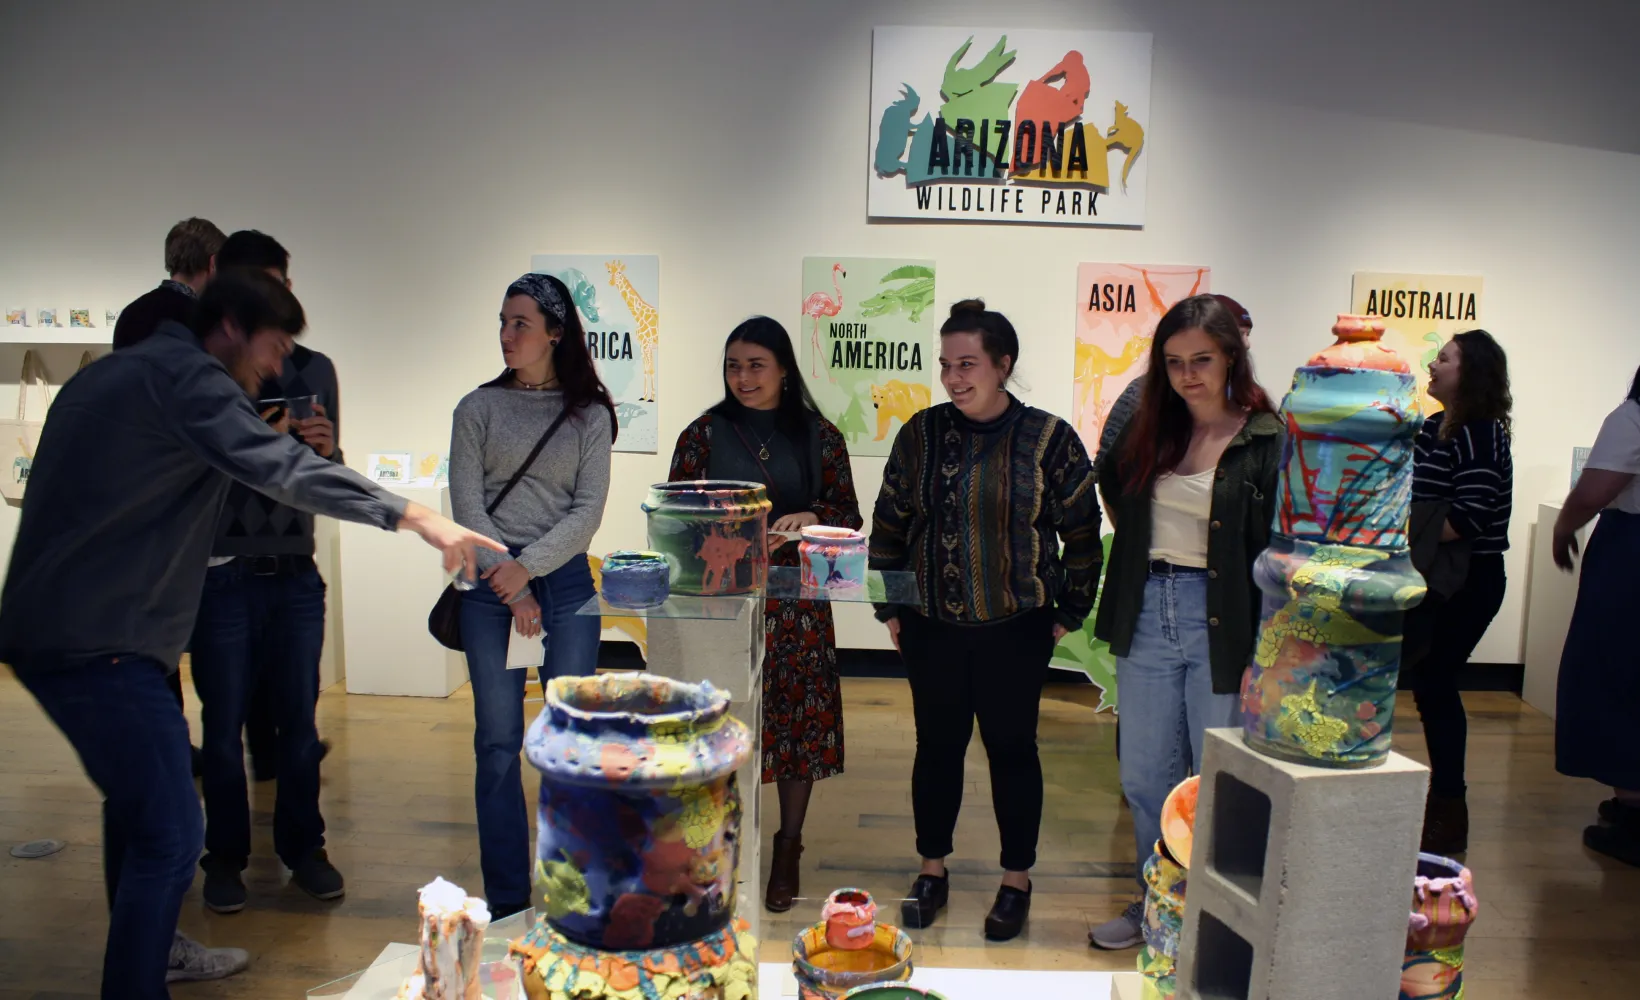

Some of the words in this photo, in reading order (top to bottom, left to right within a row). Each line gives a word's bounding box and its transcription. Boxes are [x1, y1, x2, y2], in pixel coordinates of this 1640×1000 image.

[928, 117, 1089, 173] ARIZONA
[916, 185, 1024, 214] WILDLIFE
[1041, 189, 1099, 217] PARK
[1088, 283, 1136, 313] ASIA
[1366, 289, 1477, 321] AUSTRALIA
[583, 331, 633, 360] RICA
[829, 322, 867, 339] NORTH
[831, 340, 923, 371] AMERICA
